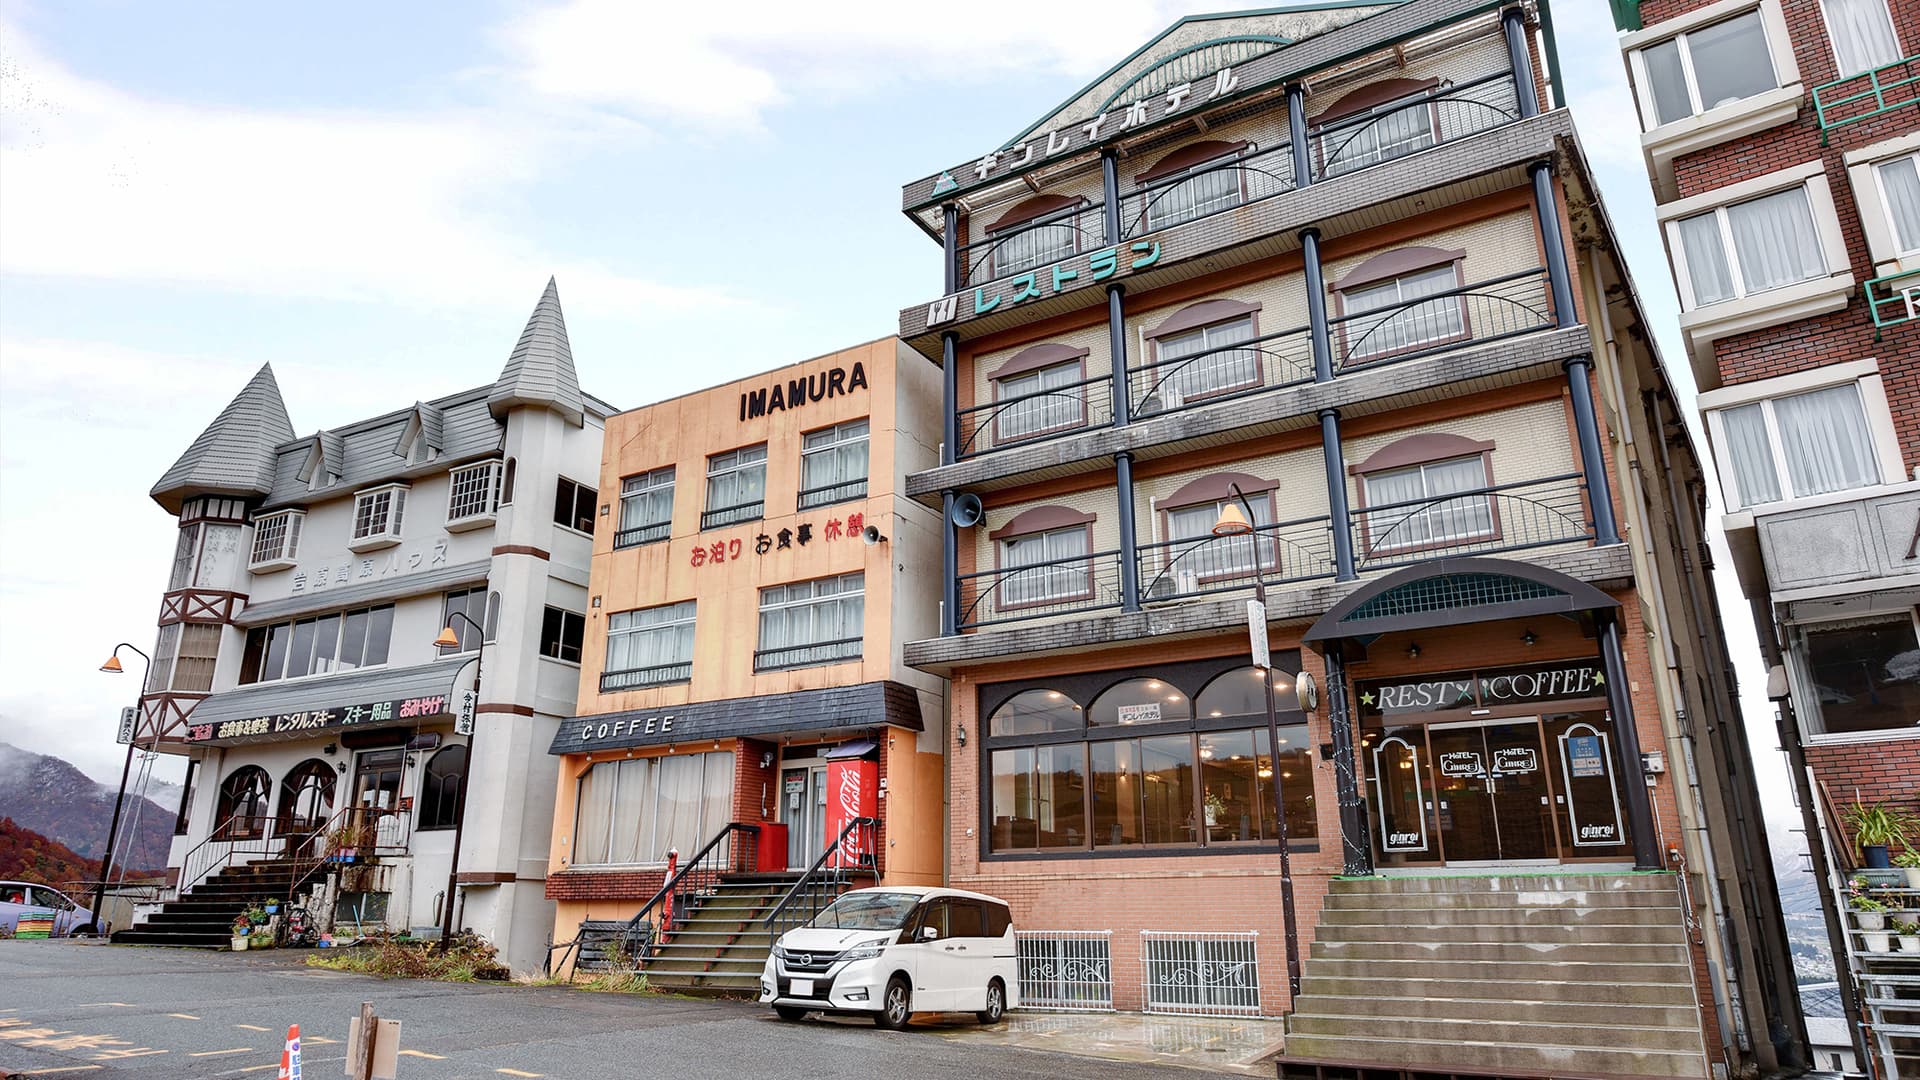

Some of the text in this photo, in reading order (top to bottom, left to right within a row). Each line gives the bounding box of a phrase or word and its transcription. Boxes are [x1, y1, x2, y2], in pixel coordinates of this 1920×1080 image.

[974, 67, 1238, 180] ギンレイホテル
[974, 241, 1161, 315] レストラン
[740, 361, 868, 422] IMAMURA
[690, 512, 865, 568] お泊り お食事 休憩
[275, 709, 336, 733] レンタルスキー
[342, 702, 392, 725] スキー用品
[400, 695, 444, 718] おみやげ
[1376, 667, 1592, 710] REST COFFEE
[582, 715, 675, 740] COFFEE
